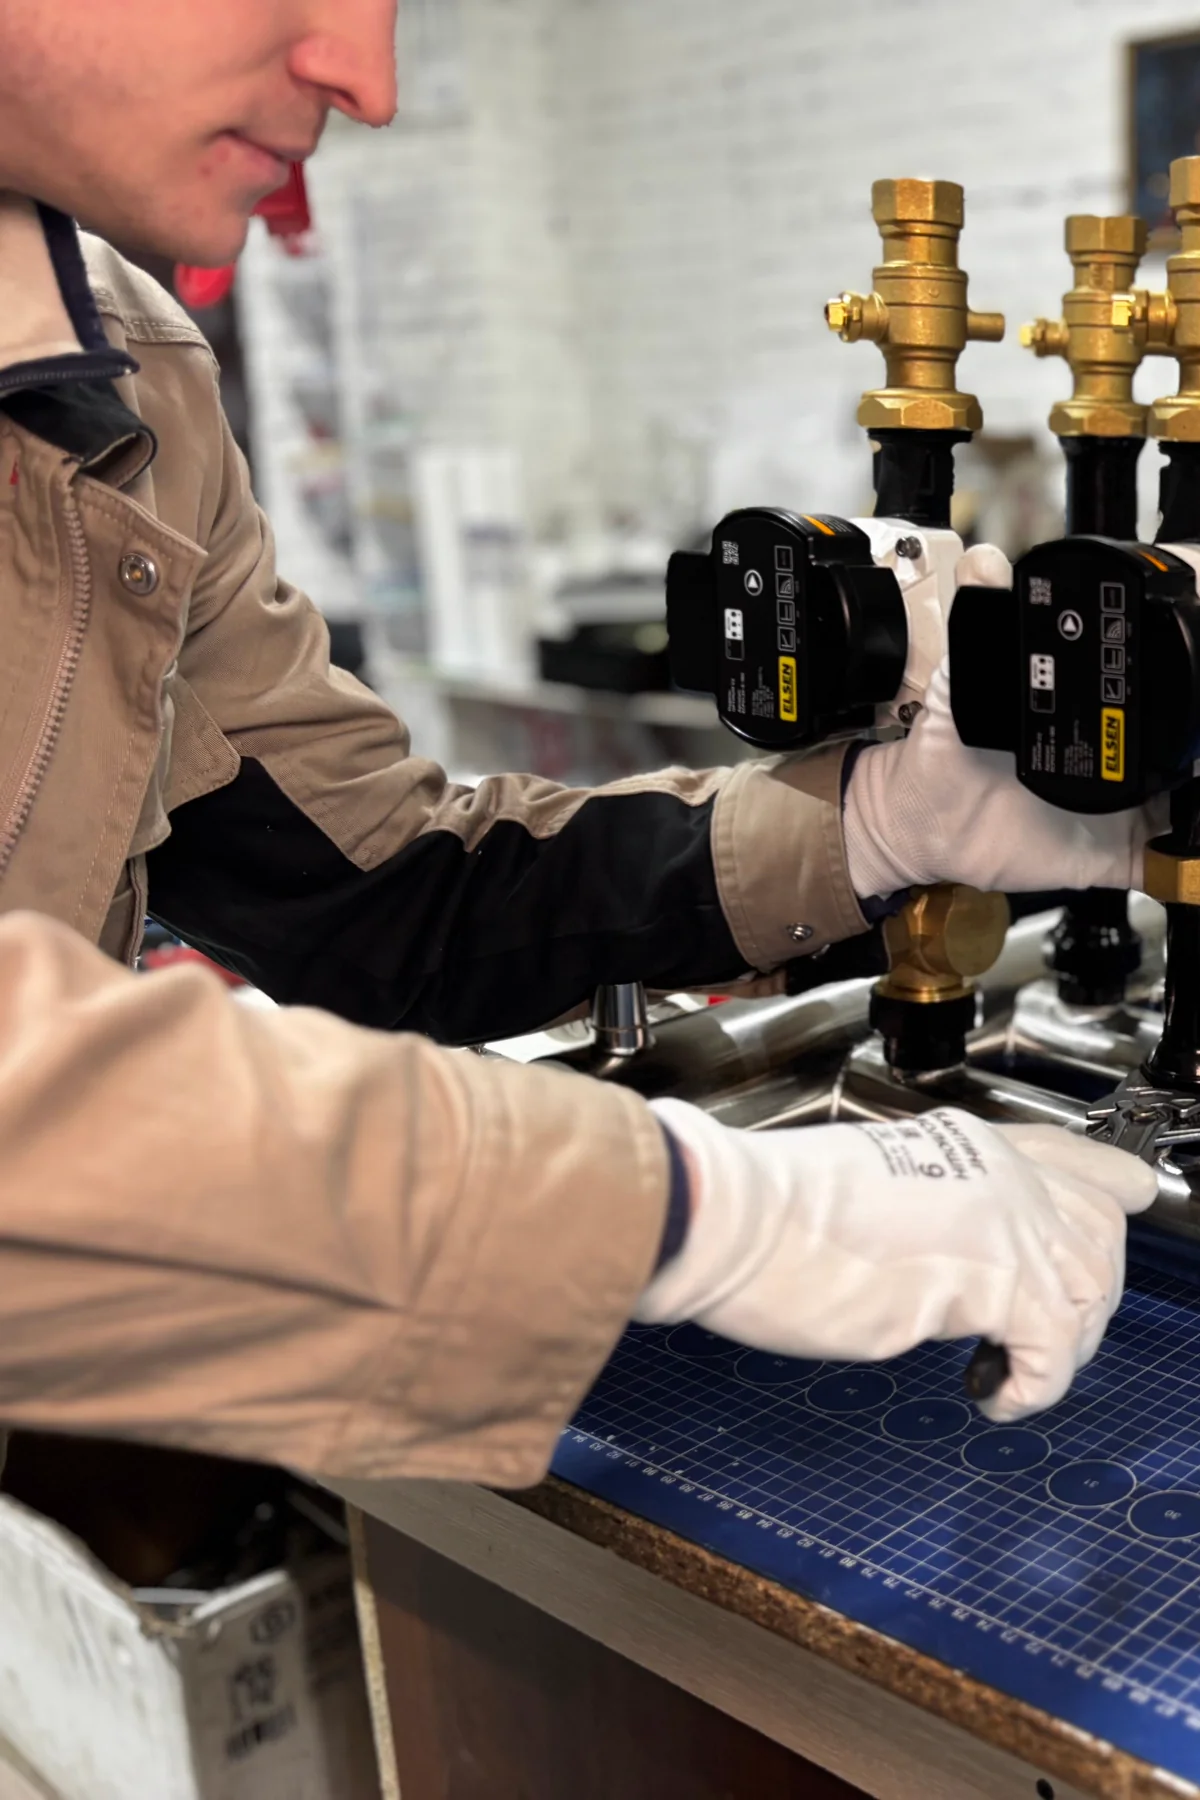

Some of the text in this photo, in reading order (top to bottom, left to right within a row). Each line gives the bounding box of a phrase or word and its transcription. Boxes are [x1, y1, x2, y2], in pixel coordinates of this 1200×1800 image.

[782, 663, 793, 715] ELSEN
[1105, 715, 1120, 773] ELSEN
[572, 1434, 588, 1443] 94
[589, 1442, 605, 1451] 93
[606, 1450, 623, 1460] 92
[624, 1459, 641, 1468] 91
[642, 1466, 658, 1476] 90
[660, 1475, 677, 1485] 89
[678, 1483, 696, 1493] 88
[696, 1492, 714, 1501] 87
[716, 1500, 734, 1511] 86
[735, 1509, 753, 1520] 85
[1164, 1509, 1182, 1520] 30
[756, 1519, 773, 1529] 84
[776, 1527, 794, 1538] 83
[796, 1537, 815, 1548] 82
[818, 1548, 836, 1558] 81
[838, 1556, 858, 1568] 80
[860, 1567, 879, 1578] 79
[882, 1577, 901, 1589] 78
[904, 1588, 924, 1599] 77
